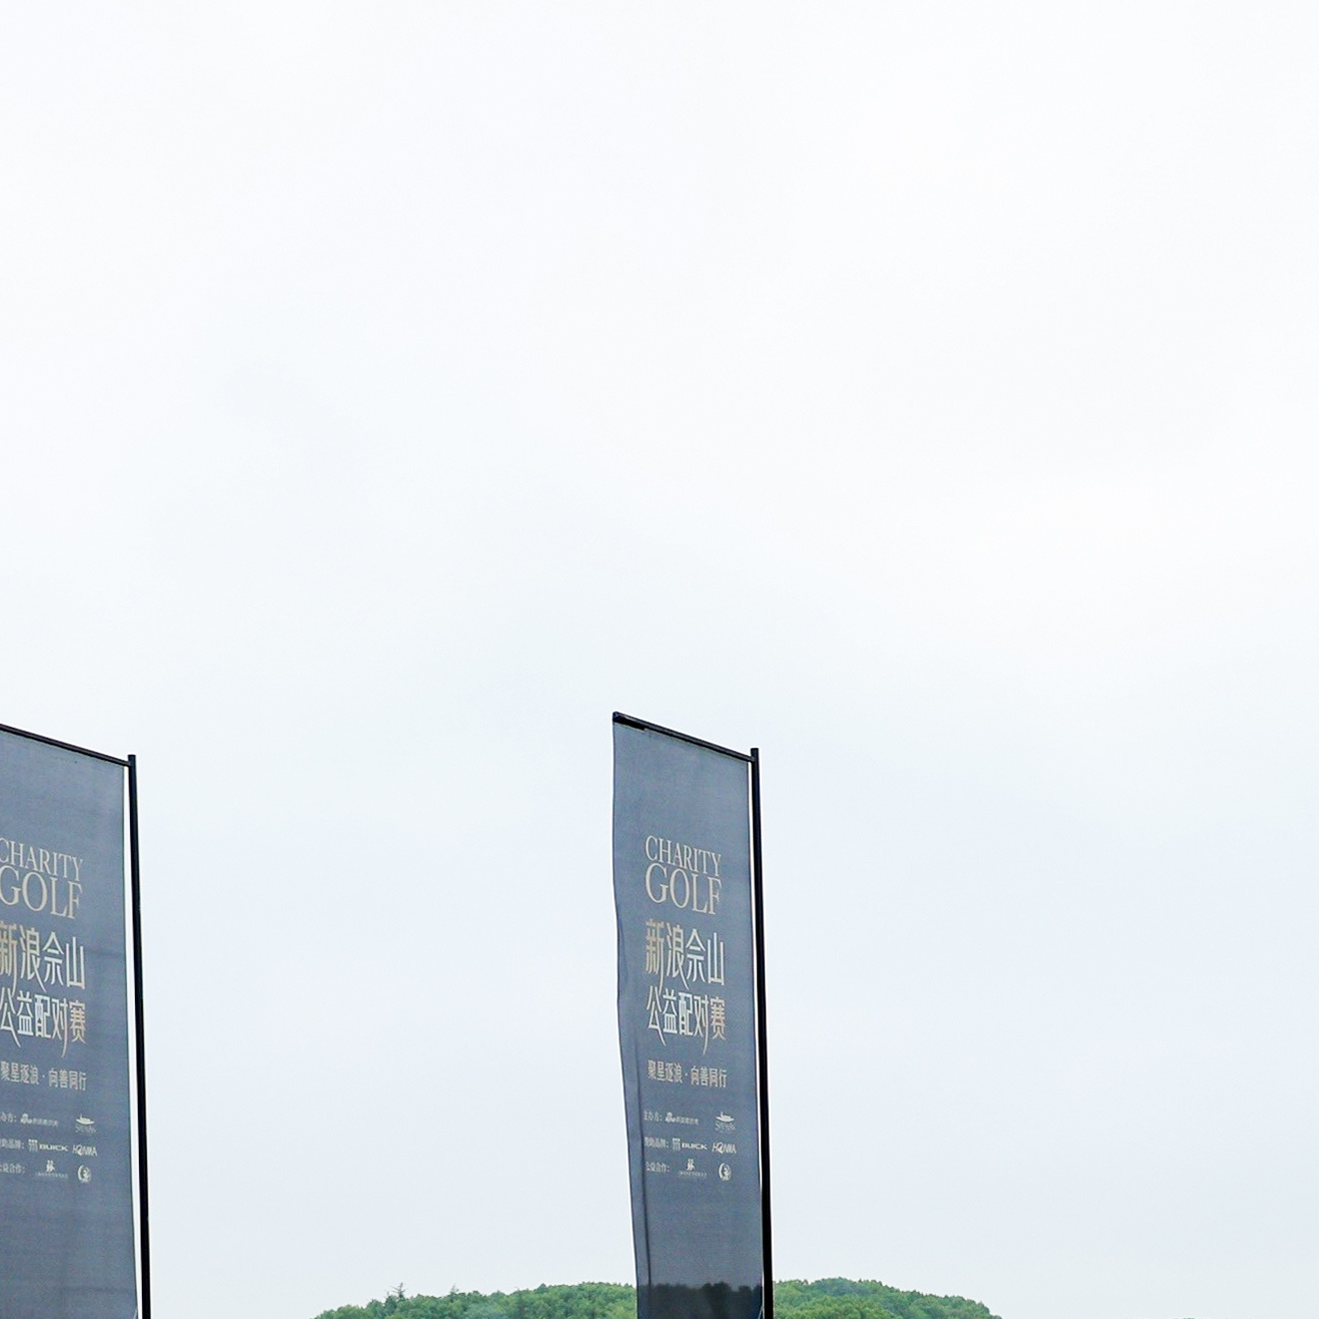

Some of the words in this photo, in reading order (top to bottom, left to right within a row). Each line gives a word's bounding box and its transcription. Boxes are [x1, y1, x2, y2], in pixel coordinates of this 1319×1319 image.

[645, 835, 721, 877] CHARITY
[645, 862, 722, 915] GOLF
[646, 918, 725, 995] 新浪佘山
[647, 985, 726, 1055] 公益配对赛
